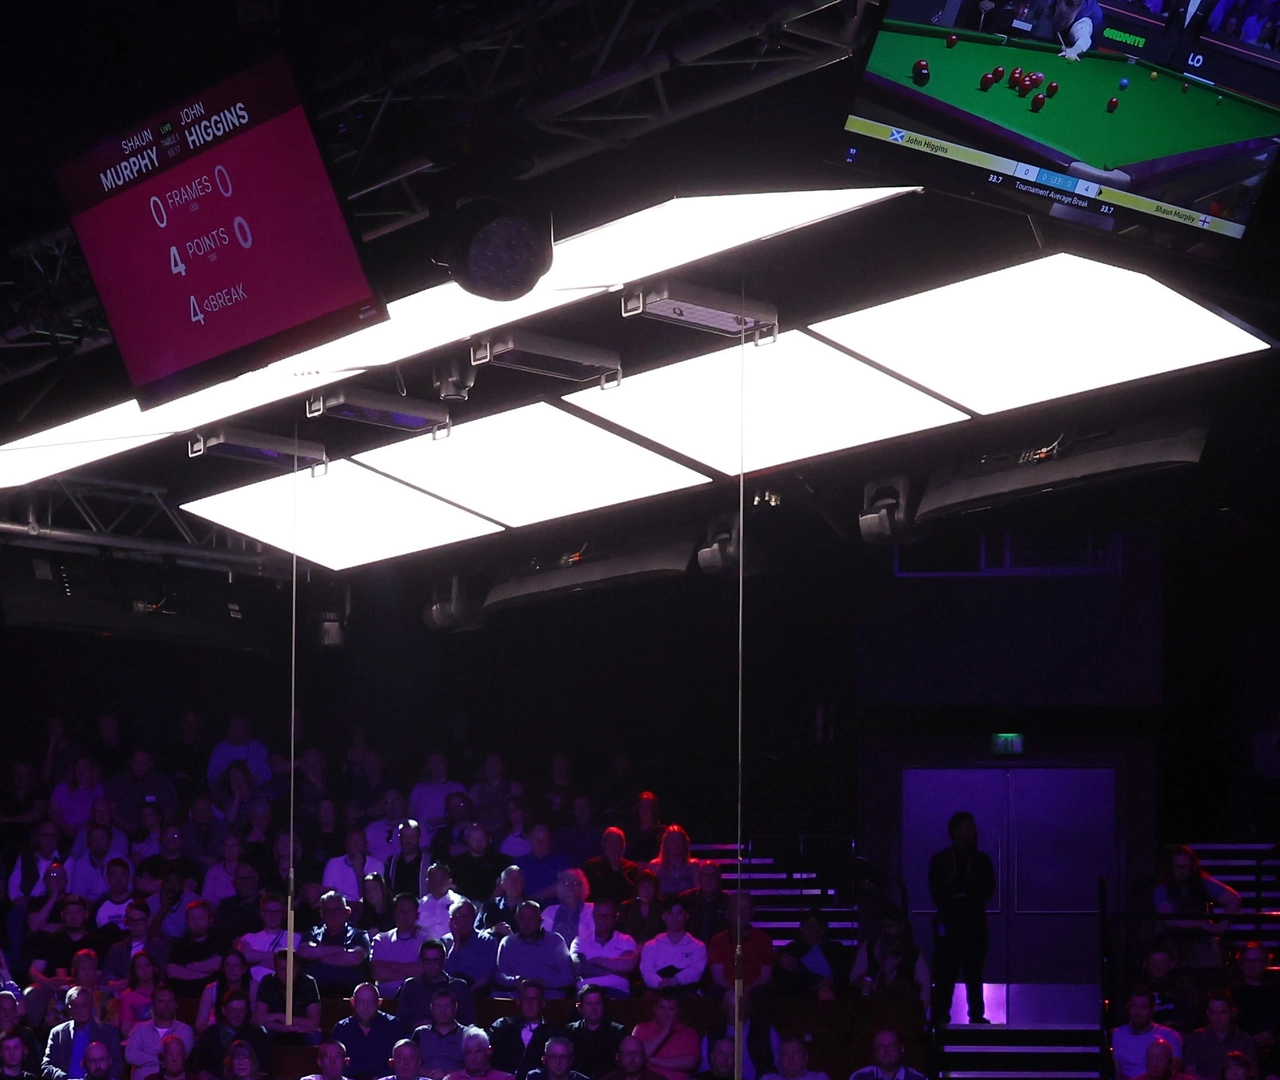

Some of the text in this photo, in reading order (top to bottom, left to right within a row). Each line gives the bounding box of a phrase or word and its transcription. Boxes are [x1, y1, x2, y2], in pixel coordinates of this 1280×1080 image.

[180, 102, 205, 125] JOHN
[185, 102, 249, 149] HIGGINS
[121, 128, 154, 154] SHAUN
[906, 135, 949, 154] John Higgins
[100, 146, 159, 192] MURPHY
[988, 174, 1003, 184] 33.7
[150, 165, 233, 228] 0 FRAMES 0
[1015, 181, 1088, 208] Tournament Average Break
[1100, 204, 1114, 214] 33.7
[1154, 205, 1196, 223] Shaun Murphy
[170, 216, 253, 276] 4 POINTS 0
[189, 282, 248, 325] 4 BREAK
